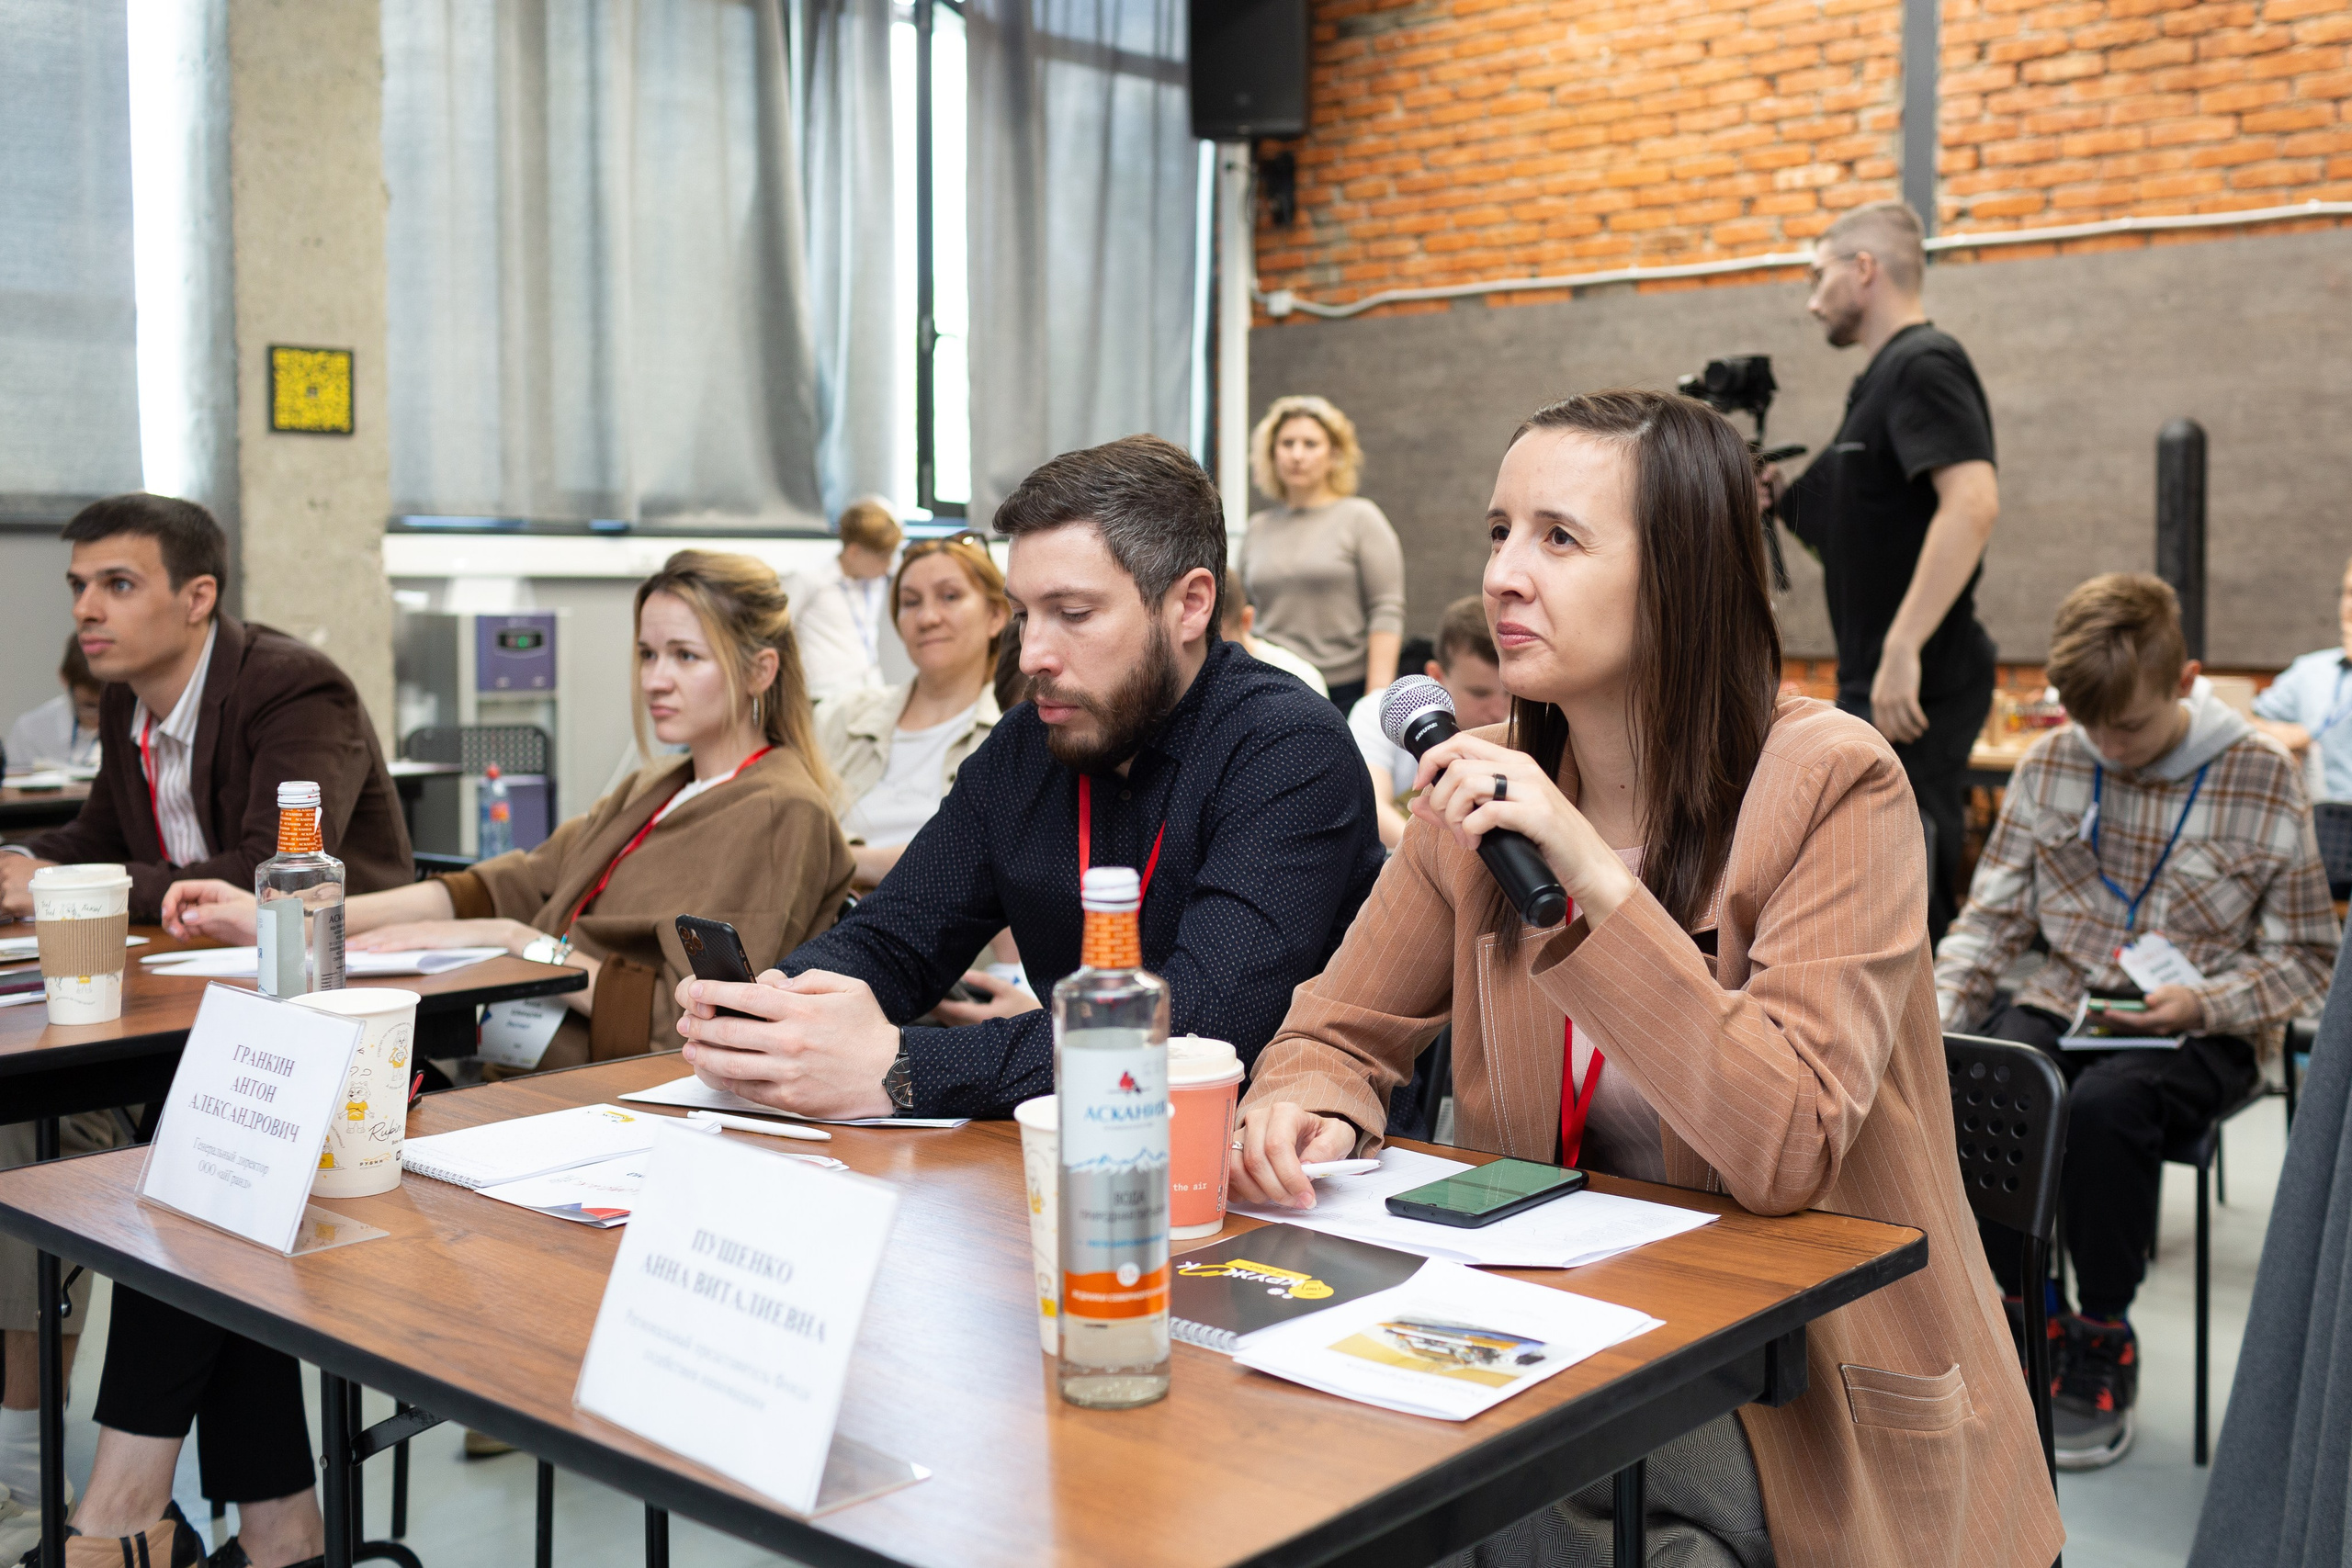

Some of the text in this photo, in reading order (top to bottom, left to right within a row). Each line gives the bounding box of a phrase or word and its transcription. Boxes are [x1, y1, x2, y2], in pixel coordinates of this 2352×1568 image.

[232, 1043, 296, 1077] ГРАНКИН
[229, 1076, 277, 1103] АНТОН
[187, 1092, 300, 1143] АЛЕКСАНДРОВИЧ
[193, 1137, 270, 1178] Генеральный директор
[198, 1159, 217, 1176] ООО
[1173, 1181, 1207, 1191] the air
[691, 1228, 795, 1286] ПУШЕНКО
[640, 1252, 827, 1344] АННА ВИТАЛИЕВНА
